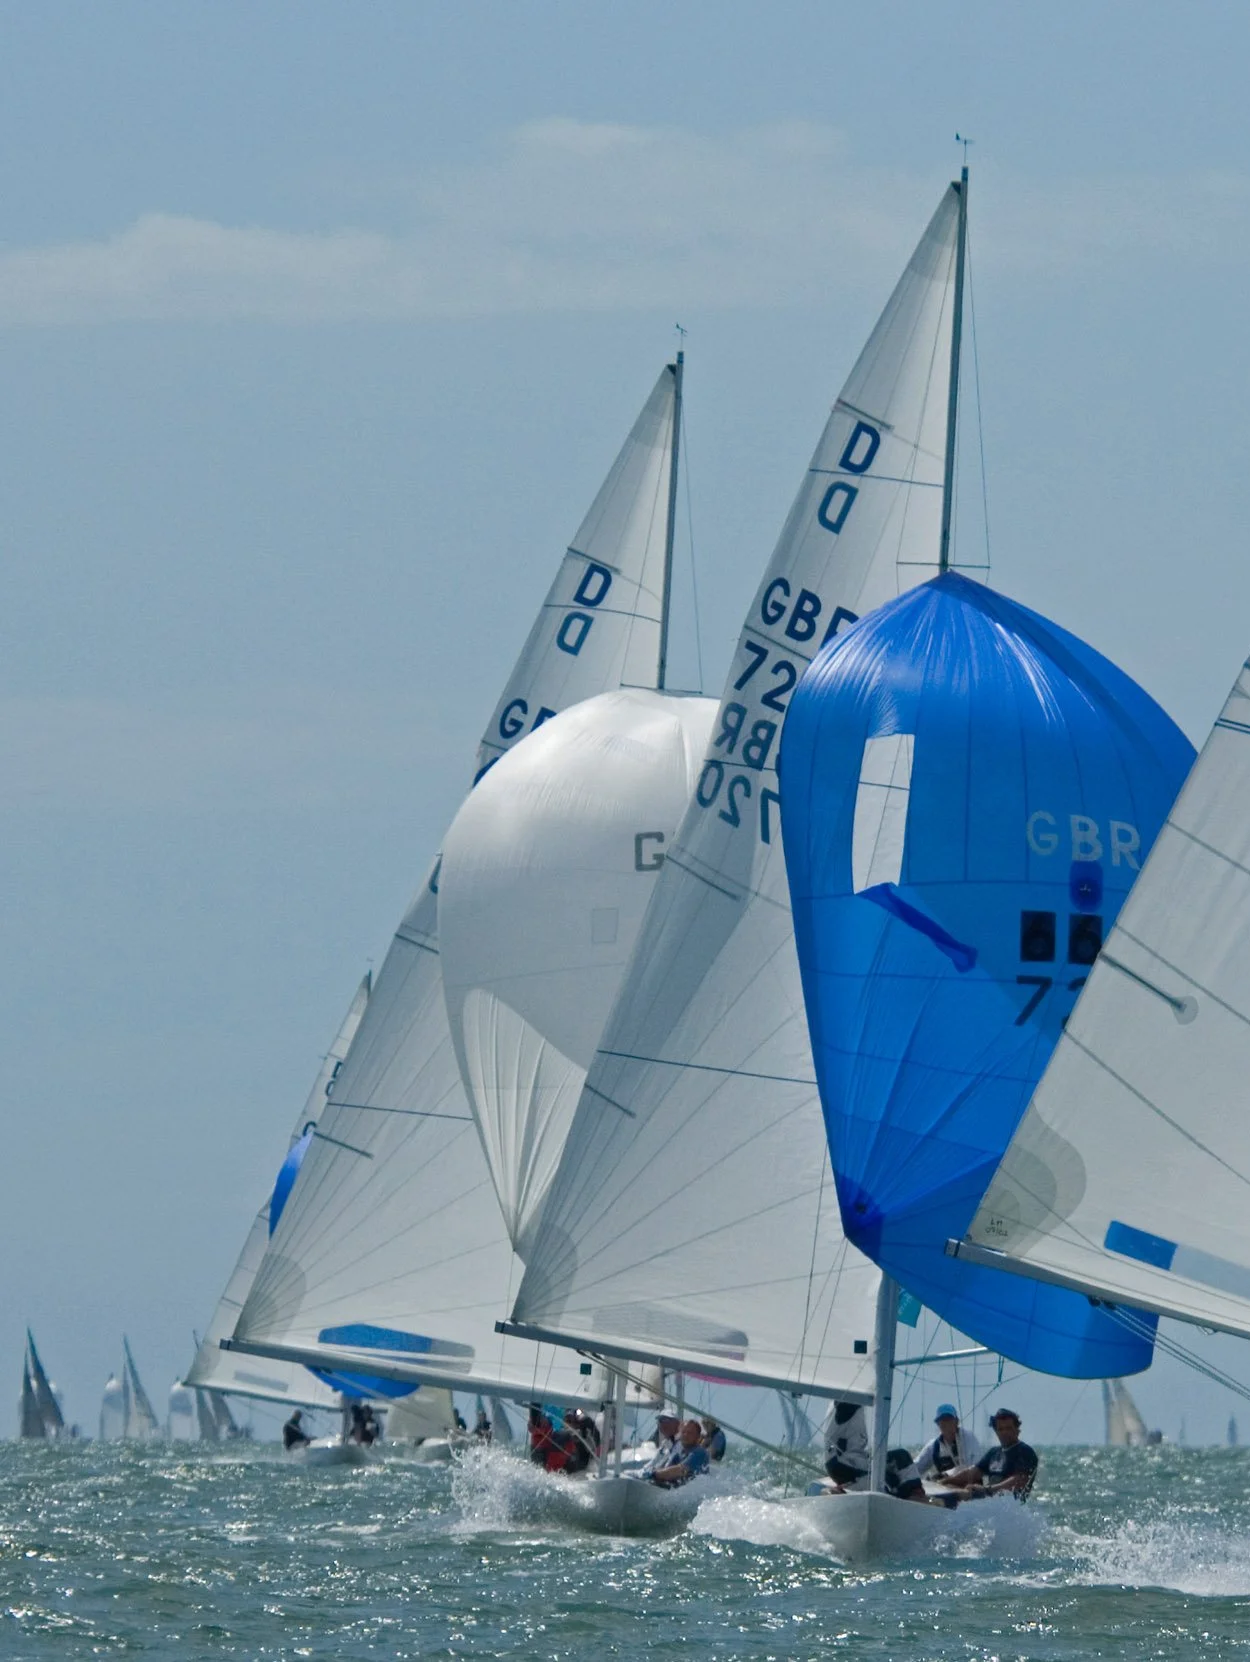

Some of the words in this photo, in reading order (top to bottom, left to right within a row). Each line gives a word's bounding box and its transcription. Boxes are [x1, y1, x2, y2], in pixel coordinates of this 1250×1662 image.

[838, 421, 880, 474] D
[573, 562, 612, 607] D
[733, 639, 797, 713] 72
[634, 831, 665, 872] G
[1026, 810, 1141, 871] GBR
